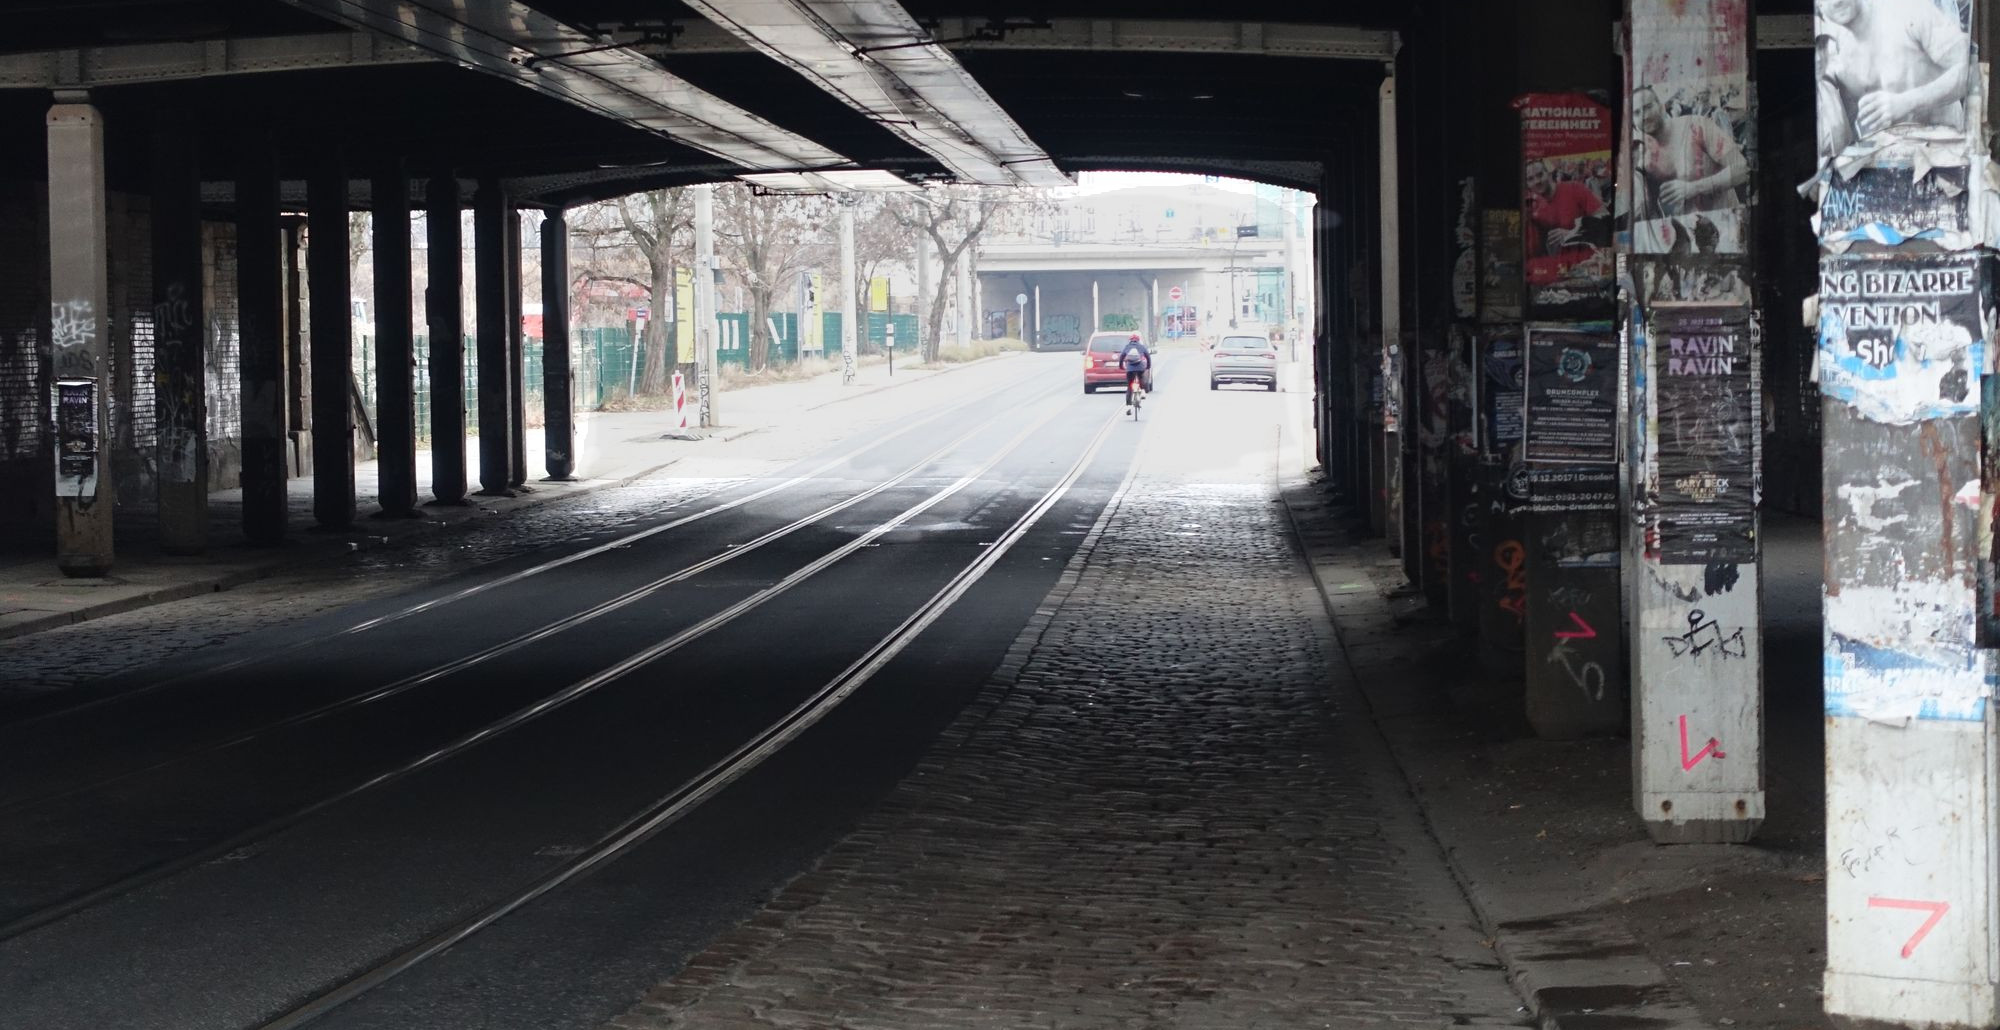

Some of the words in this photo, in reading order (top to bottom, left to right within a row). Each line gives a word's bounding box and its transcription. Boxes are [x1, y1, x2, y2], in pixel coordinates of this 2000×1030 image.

[1862, 268, 1973, 296] BIZARRE
[1670, 335, 1738, 356] RAVIN'
[1669, 357, 1737, 375] RAVIN'
[1546, 388, 1600, 396] DRUMCOMPLEX
[1579, 473, 1614, 481] Dresden
[1675, 478, 1701, 488] GARY
[1704, 478, 1729, 488] BECK
